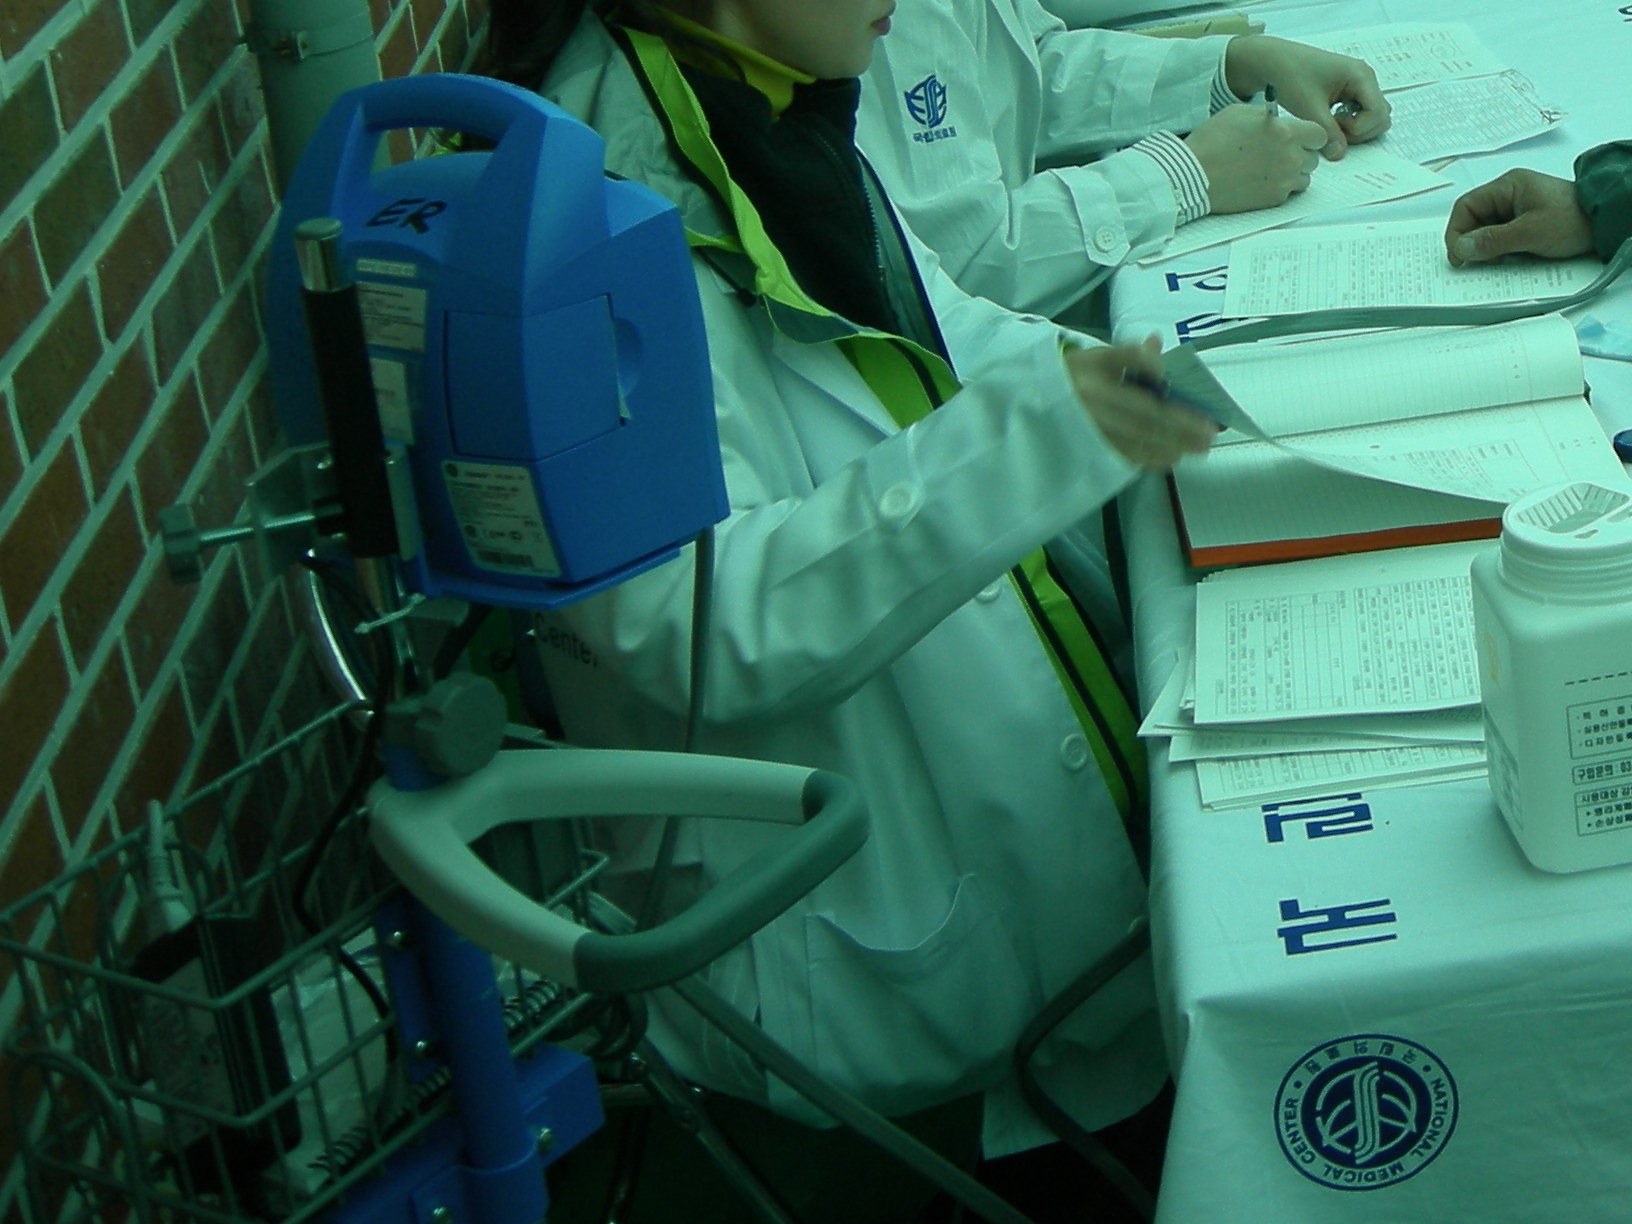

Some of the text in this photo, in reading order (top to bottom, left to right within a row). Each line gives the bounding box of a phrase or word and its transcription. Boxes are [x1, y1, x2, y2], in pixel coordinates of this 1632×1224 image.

[365, 198, 447, 234] ER
[1284, 1077, 1449, 1184] NATIONAL MEDICAL CENTER
